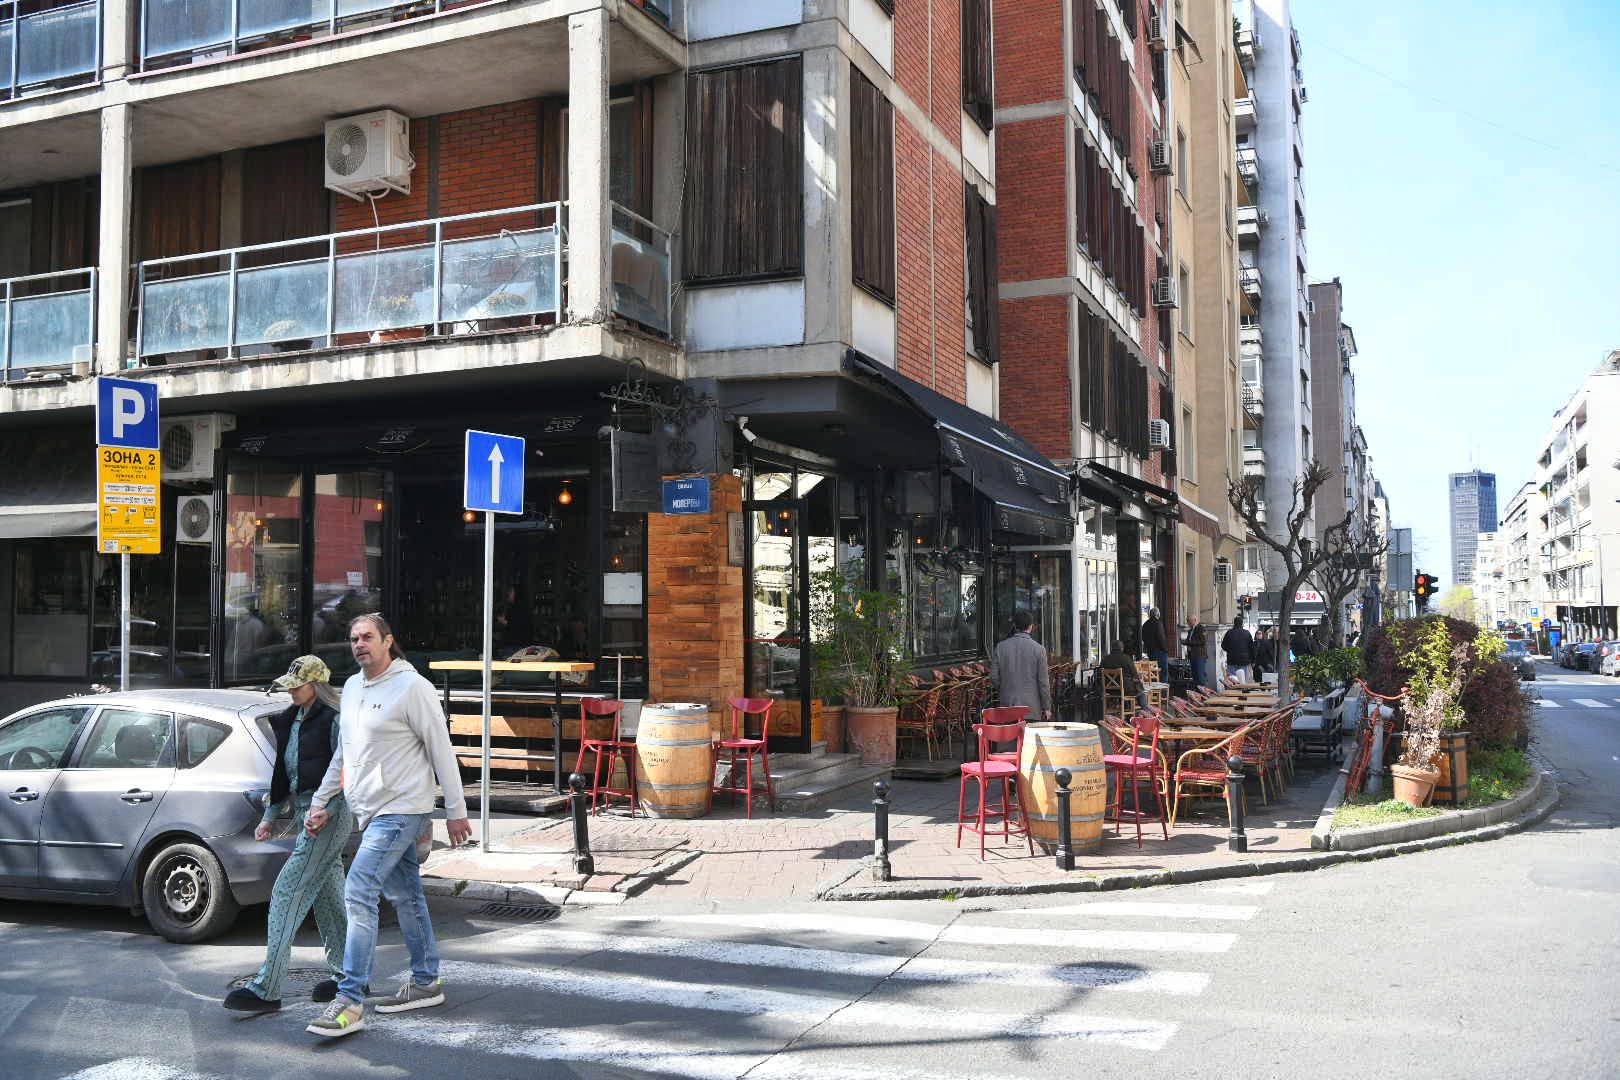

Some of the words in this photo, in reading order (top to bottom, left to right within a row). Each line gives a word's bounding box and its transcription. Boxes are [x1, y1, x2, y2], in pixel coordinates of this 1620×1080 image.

[112, 386, 146, 438] P
[103, 450, 141, 464] ЗОНА
[148, 454, 156, 465] 2
